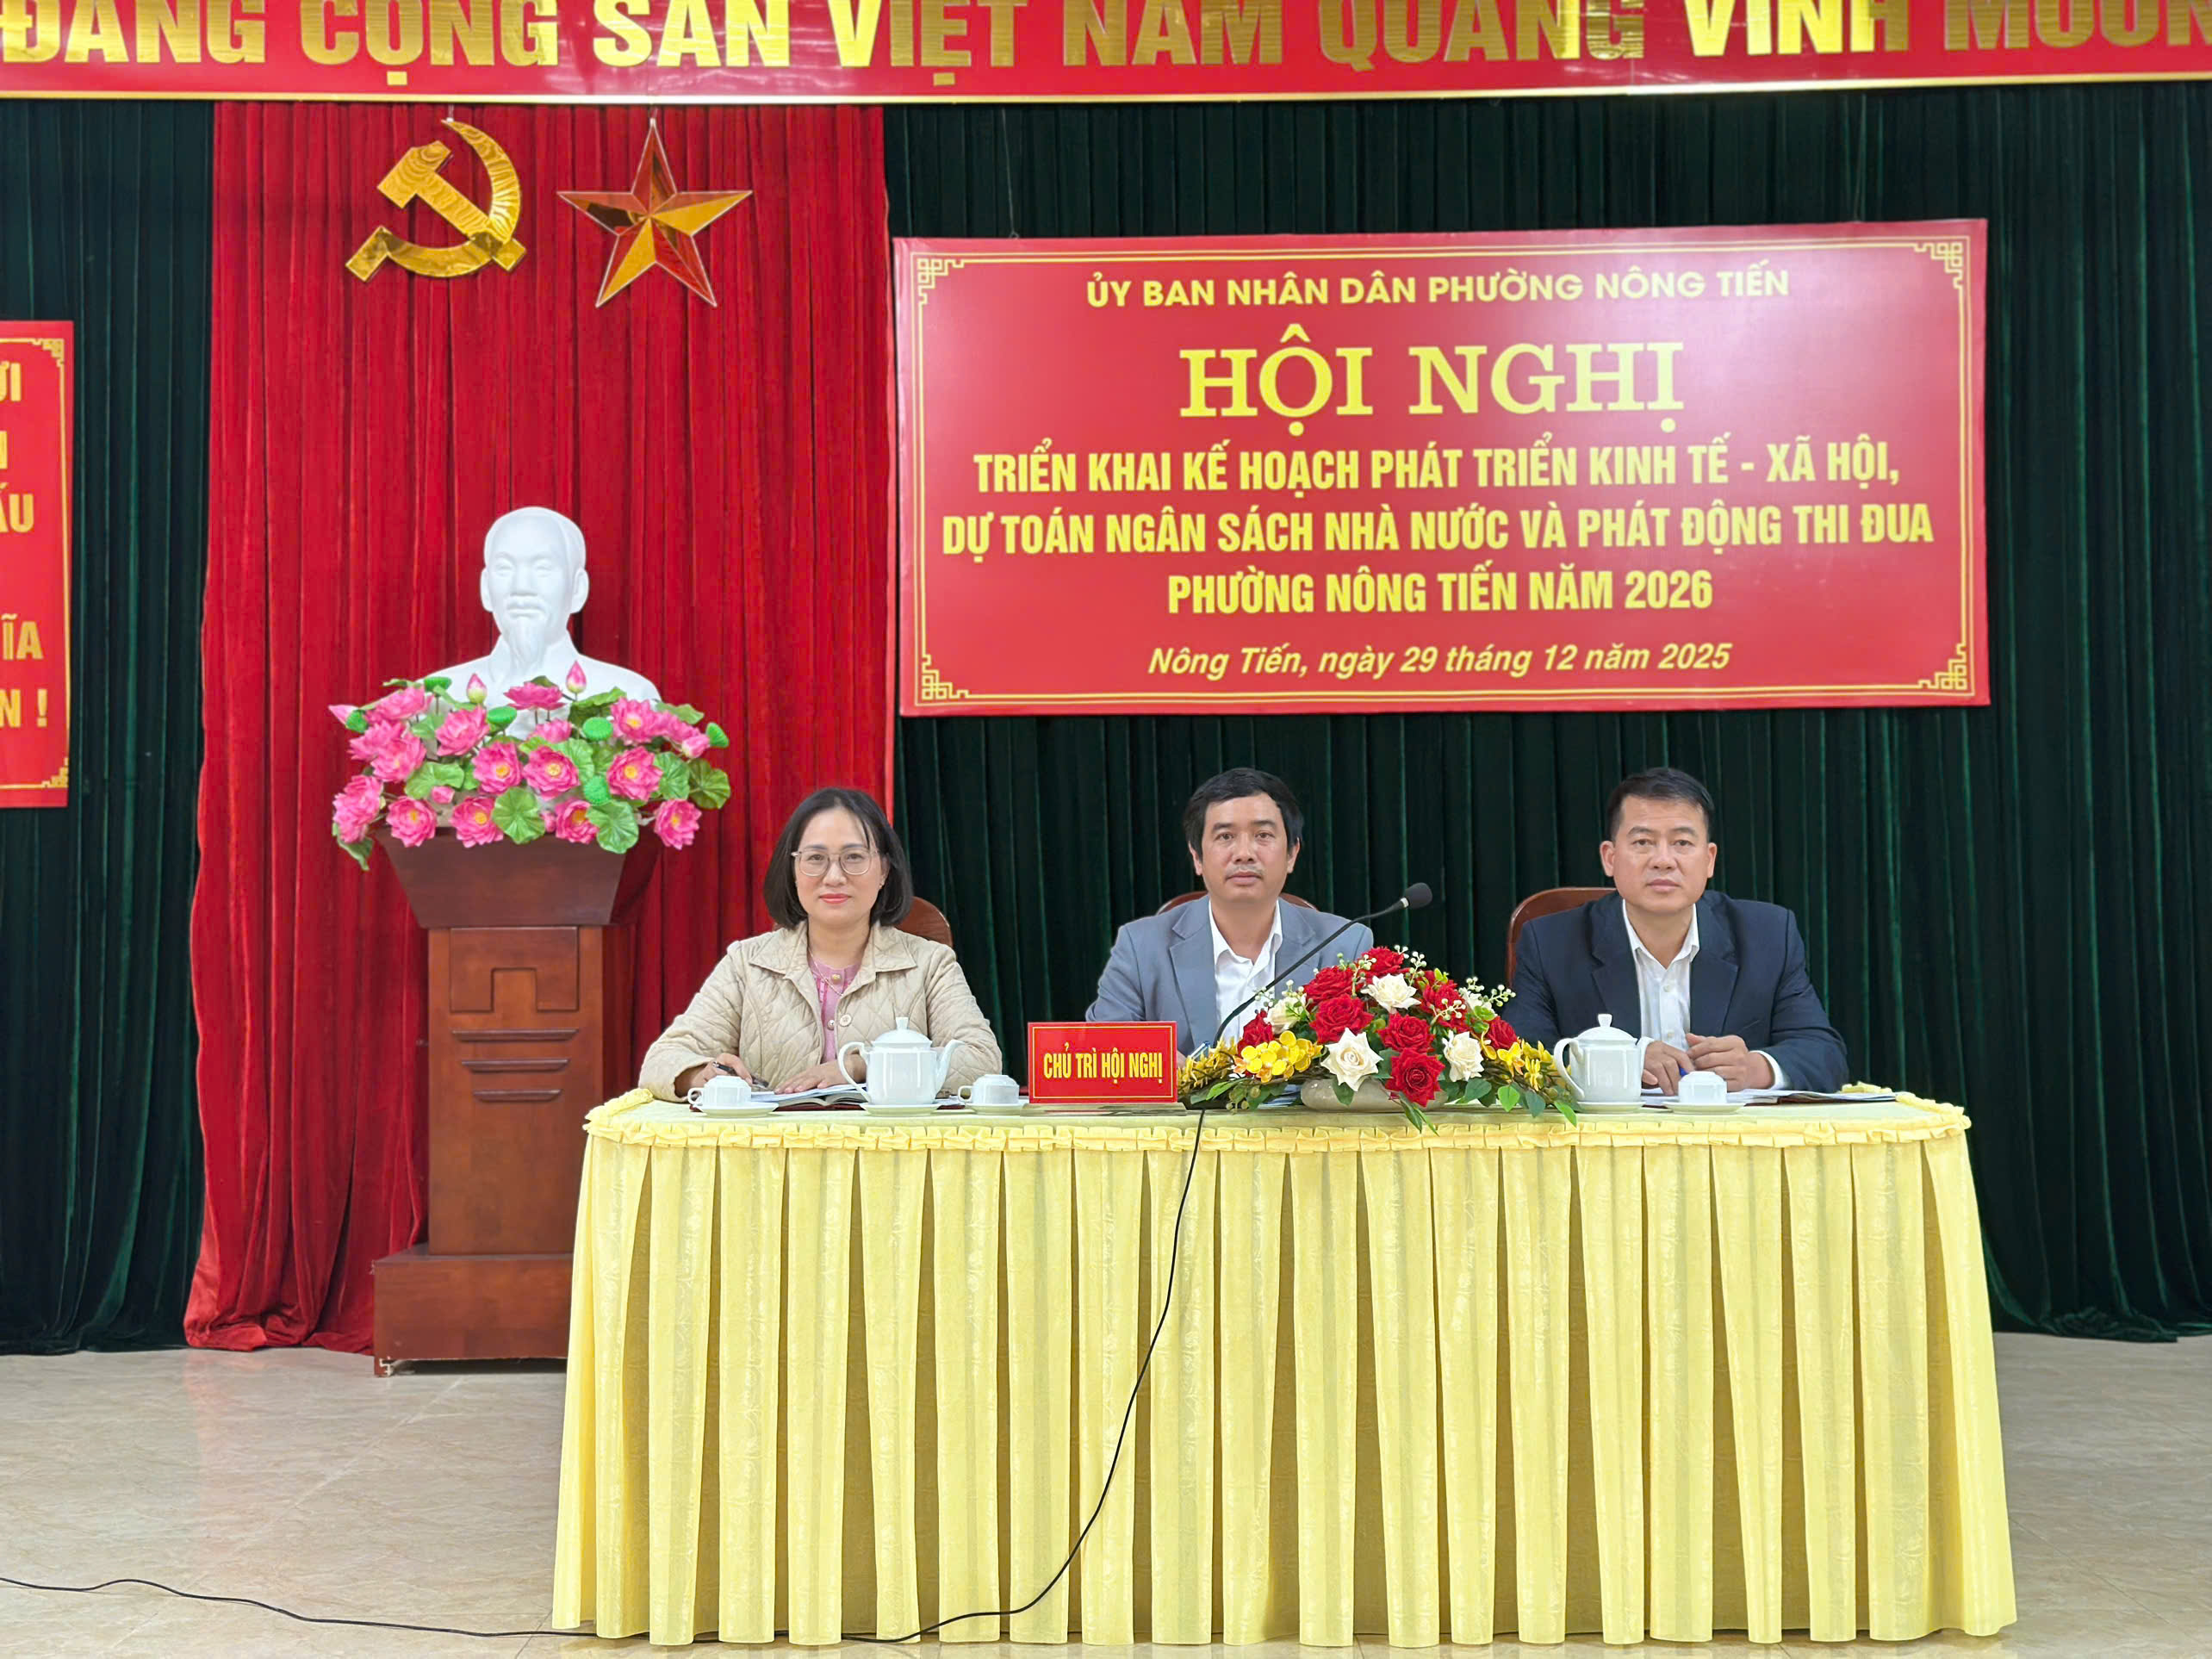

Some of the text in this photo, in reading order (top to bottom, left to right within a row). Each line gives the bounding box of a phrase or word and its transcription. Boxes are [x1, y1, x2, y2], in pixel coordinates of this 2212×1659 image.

[1063, 0, 1283, 66] NAM
[1319, 0, 1644, 71] QUANG
[1684, 0, 1910, 57] VINH
[1086, 258, 1789, 308] ỦY BAN NHÂN DÂN PHƯỜNG NÔNG TIẾN
[1179, 323, 1685, 436] HỘI NGHỊ
[973, 432, 1900, 498] TRIỂN KHAI KẾ HOẠCH PHÁT TRIỂN KINH TẾ - XÃ HỘI,
[943, 499, 1935, 562] DỰ TOÁN NGÂN SÁCH NHÀ NƯỚC VÀ PHÁT ĐỘNG THI ĐUA
[1168, 559, 1713, 614] PHƯỜNG NÔNG TIẾN NĂM 2026
[1148, 642, 1734, 681] Nông Tiến, ngày 29 tháng 12 năm 2025
[1043, 1041, 1163, 1084] CHỦ TRÌ HỘI NGHỊ
